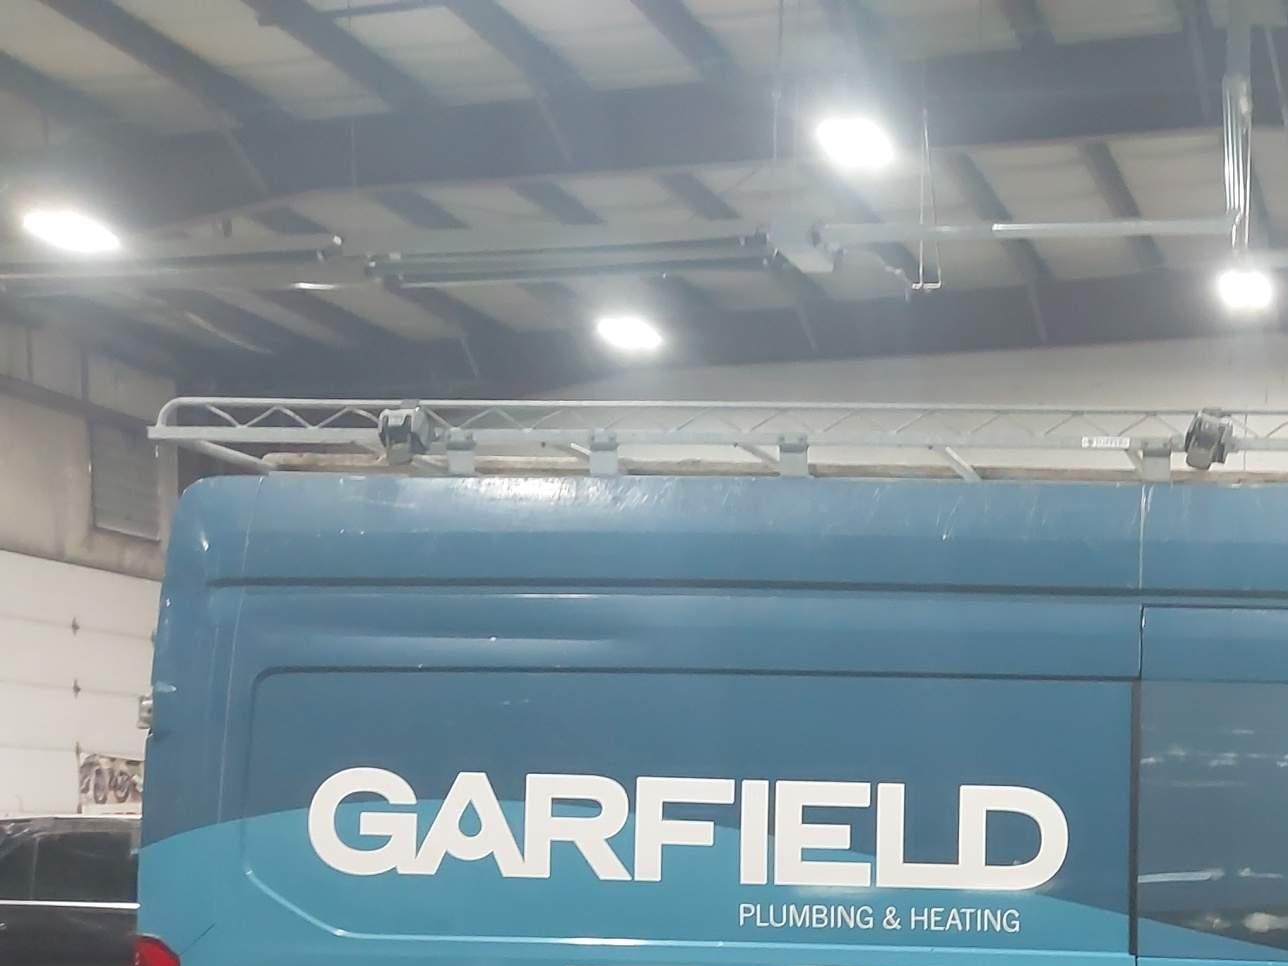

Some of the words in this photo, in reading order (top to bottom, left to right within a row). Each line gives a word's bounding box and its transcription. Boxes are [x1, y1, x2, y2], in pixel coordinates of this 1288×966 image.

[307, 766, 1070, 891] GARFIELD
[738, 903, 874, 930] PLUMBING
[882, 906, 902, 930] &
[910, 907, 1020, 933] HEATING
